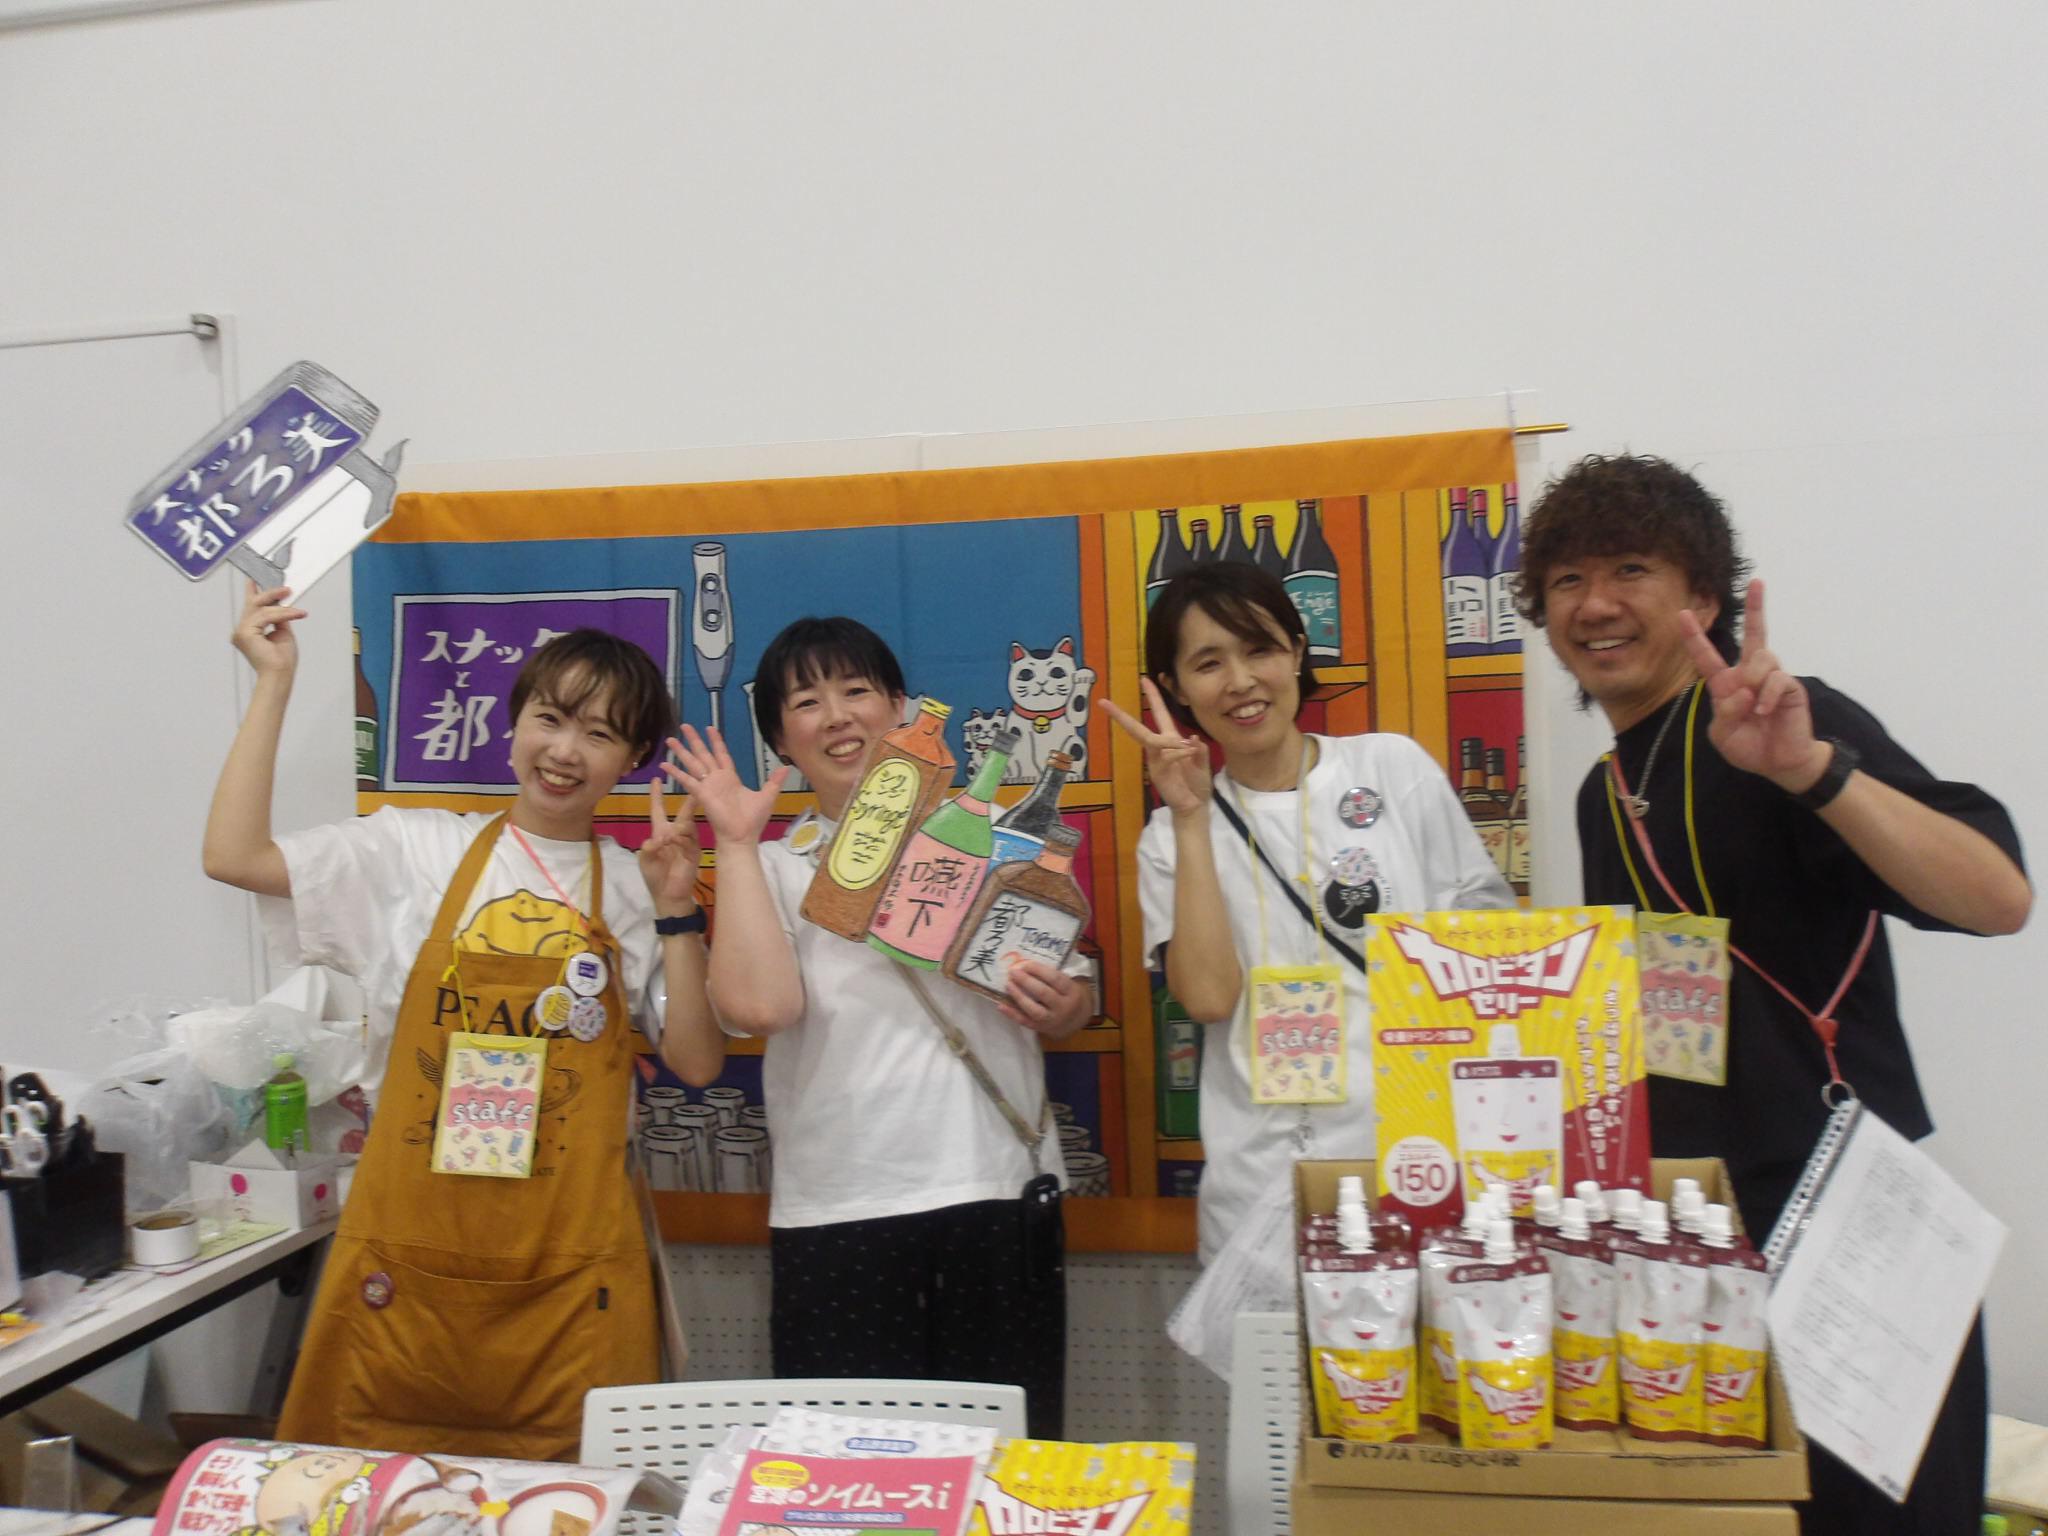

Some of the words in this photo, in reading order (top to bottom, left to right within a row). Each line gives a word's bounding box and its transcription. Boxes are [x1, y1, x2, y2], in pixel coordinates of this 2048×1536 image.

[456, 670, 476, 688] と
[413, 688, 514, 766] 都
[1263, 1026, 1339, 1051] staff
[453, 1098, 533, 1125] staff
[1391, 1163, 1447, 1192] 150
